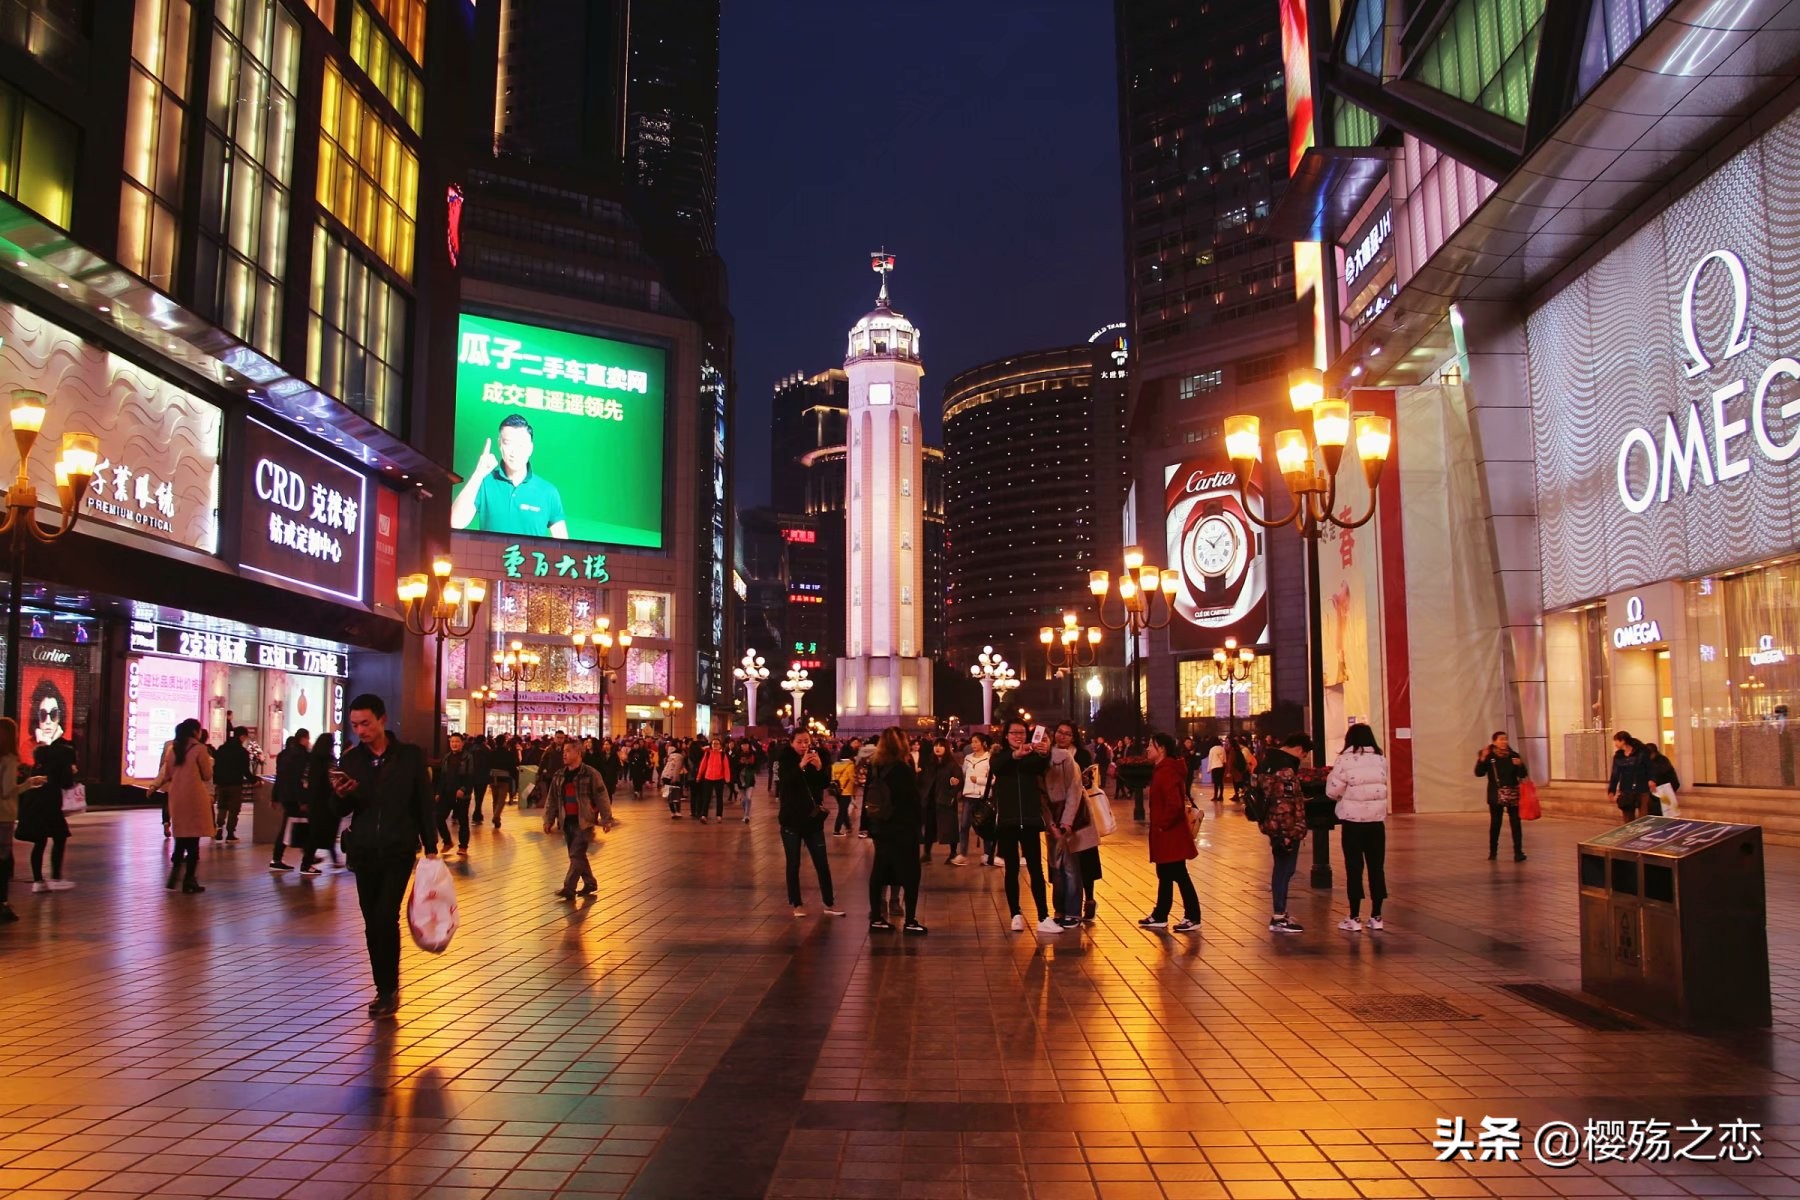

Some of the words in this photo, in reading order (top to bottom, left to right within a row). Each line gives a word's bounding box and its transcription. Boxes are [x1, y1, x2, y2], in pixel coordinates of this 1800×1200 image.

[458, 332, 647, 394] 瓜子二手车直卖网
[1100, 370, 1128, 379] 大世界
[482, 381, 624, 421] 成交量遥遥领先
[255, 458, 306, 512] CRD
[1186, 470, 1236, 493] Cartier
[87, 497, 134, 521] PREMIUM
[135, 512, 174, 533] OPTICAL
[1613, 620, 1661, 649] OMEGA
[33, 645, 71, 663] Cartier
[1195, 674, 1252, 697] Cartier
